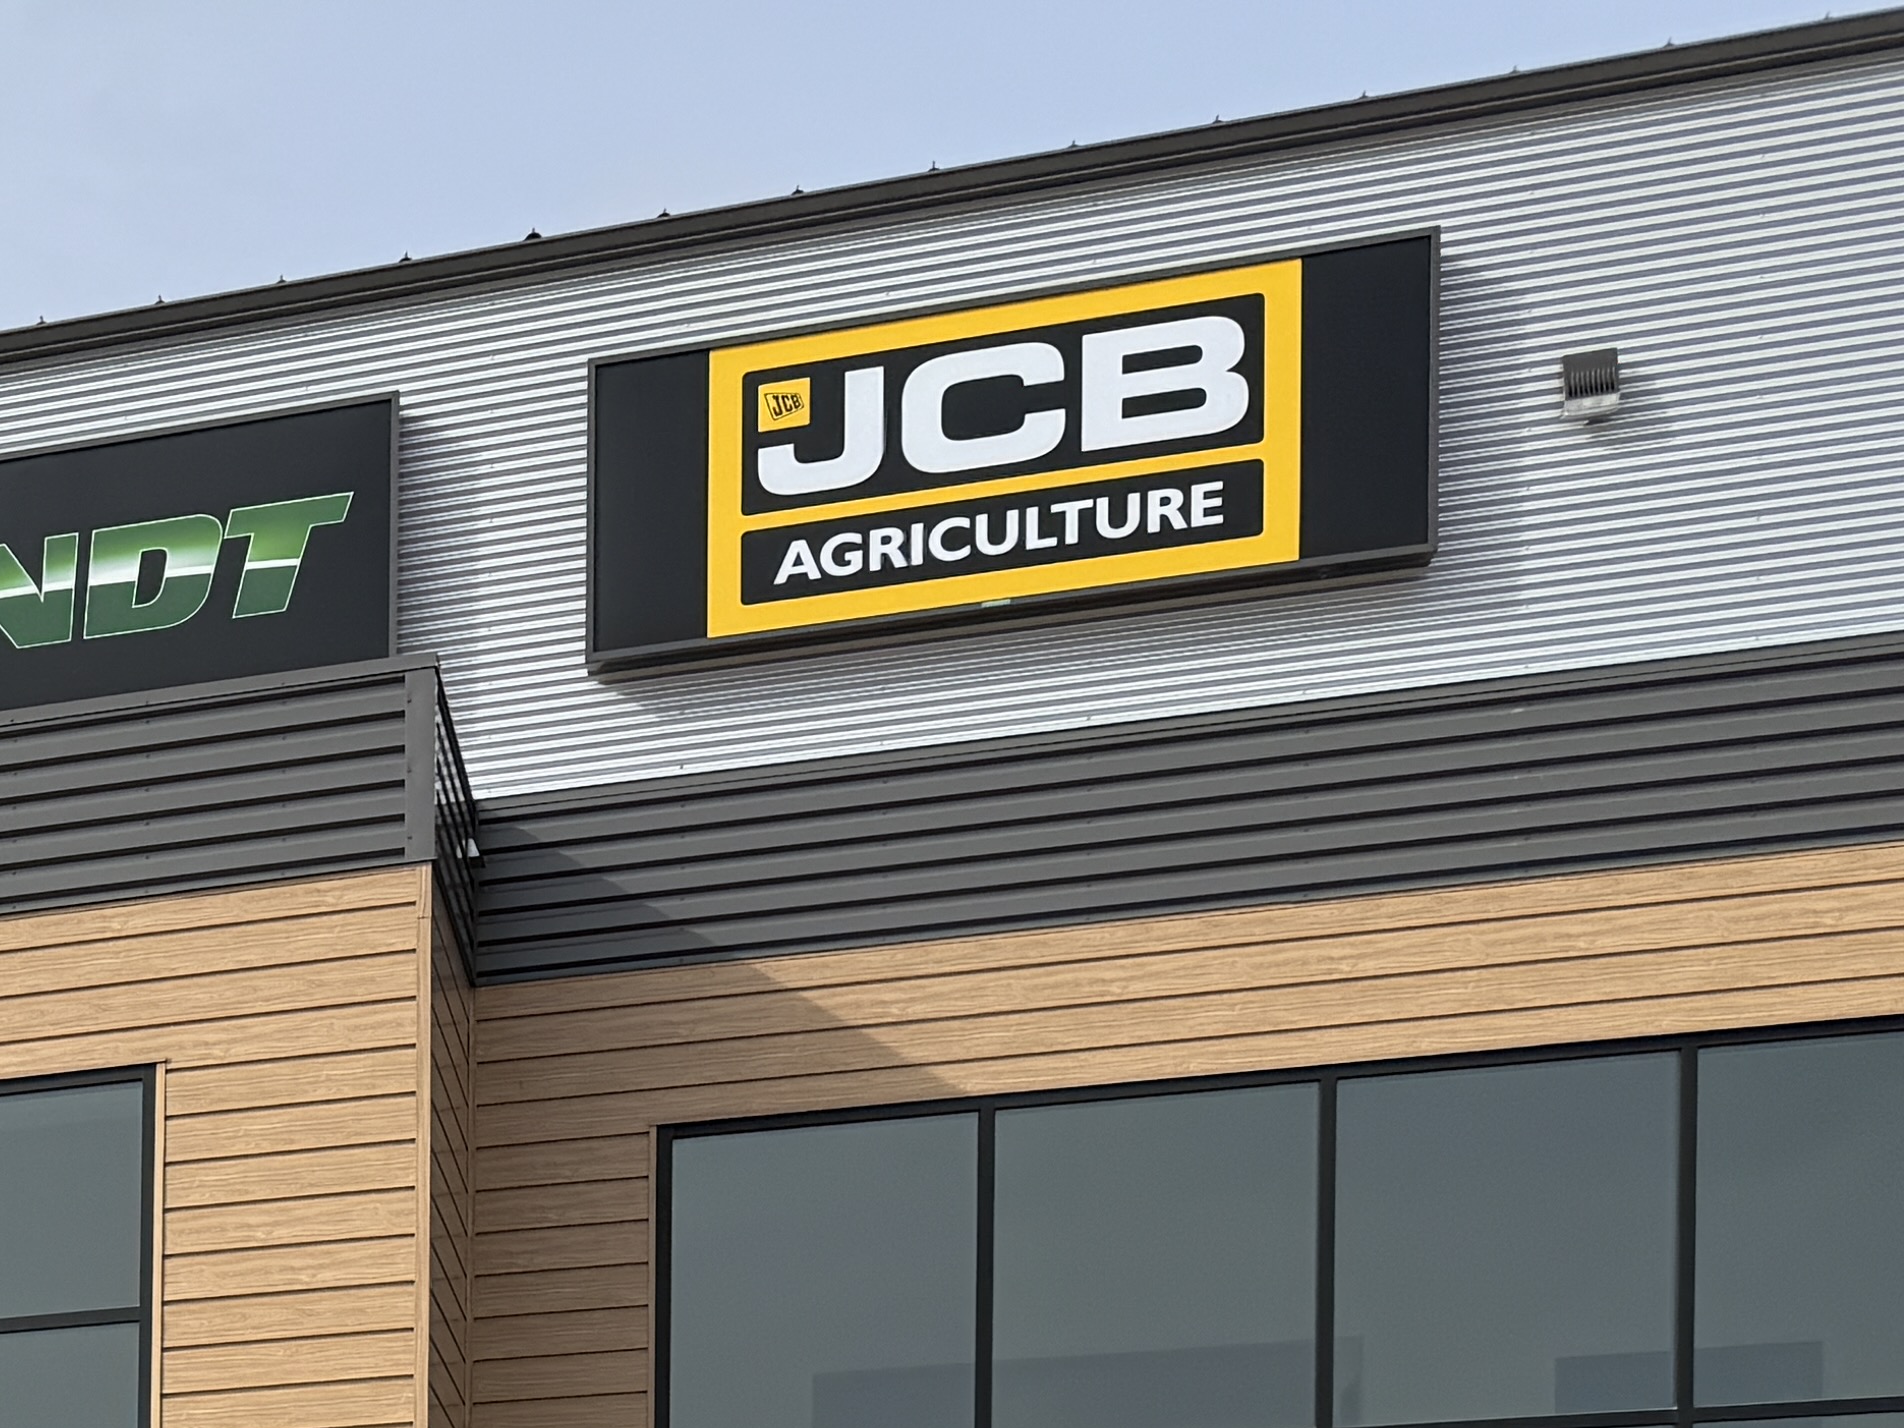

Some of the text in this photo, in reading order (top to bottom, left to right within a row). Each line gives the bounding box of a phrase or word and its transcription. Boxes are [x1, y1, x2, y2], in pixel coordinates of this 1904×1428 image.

[758, 315, 1250, 496] JCB
[772, 394, 802, 417] JCB
[773, 480, 1224, 585] AGRICULTURE
